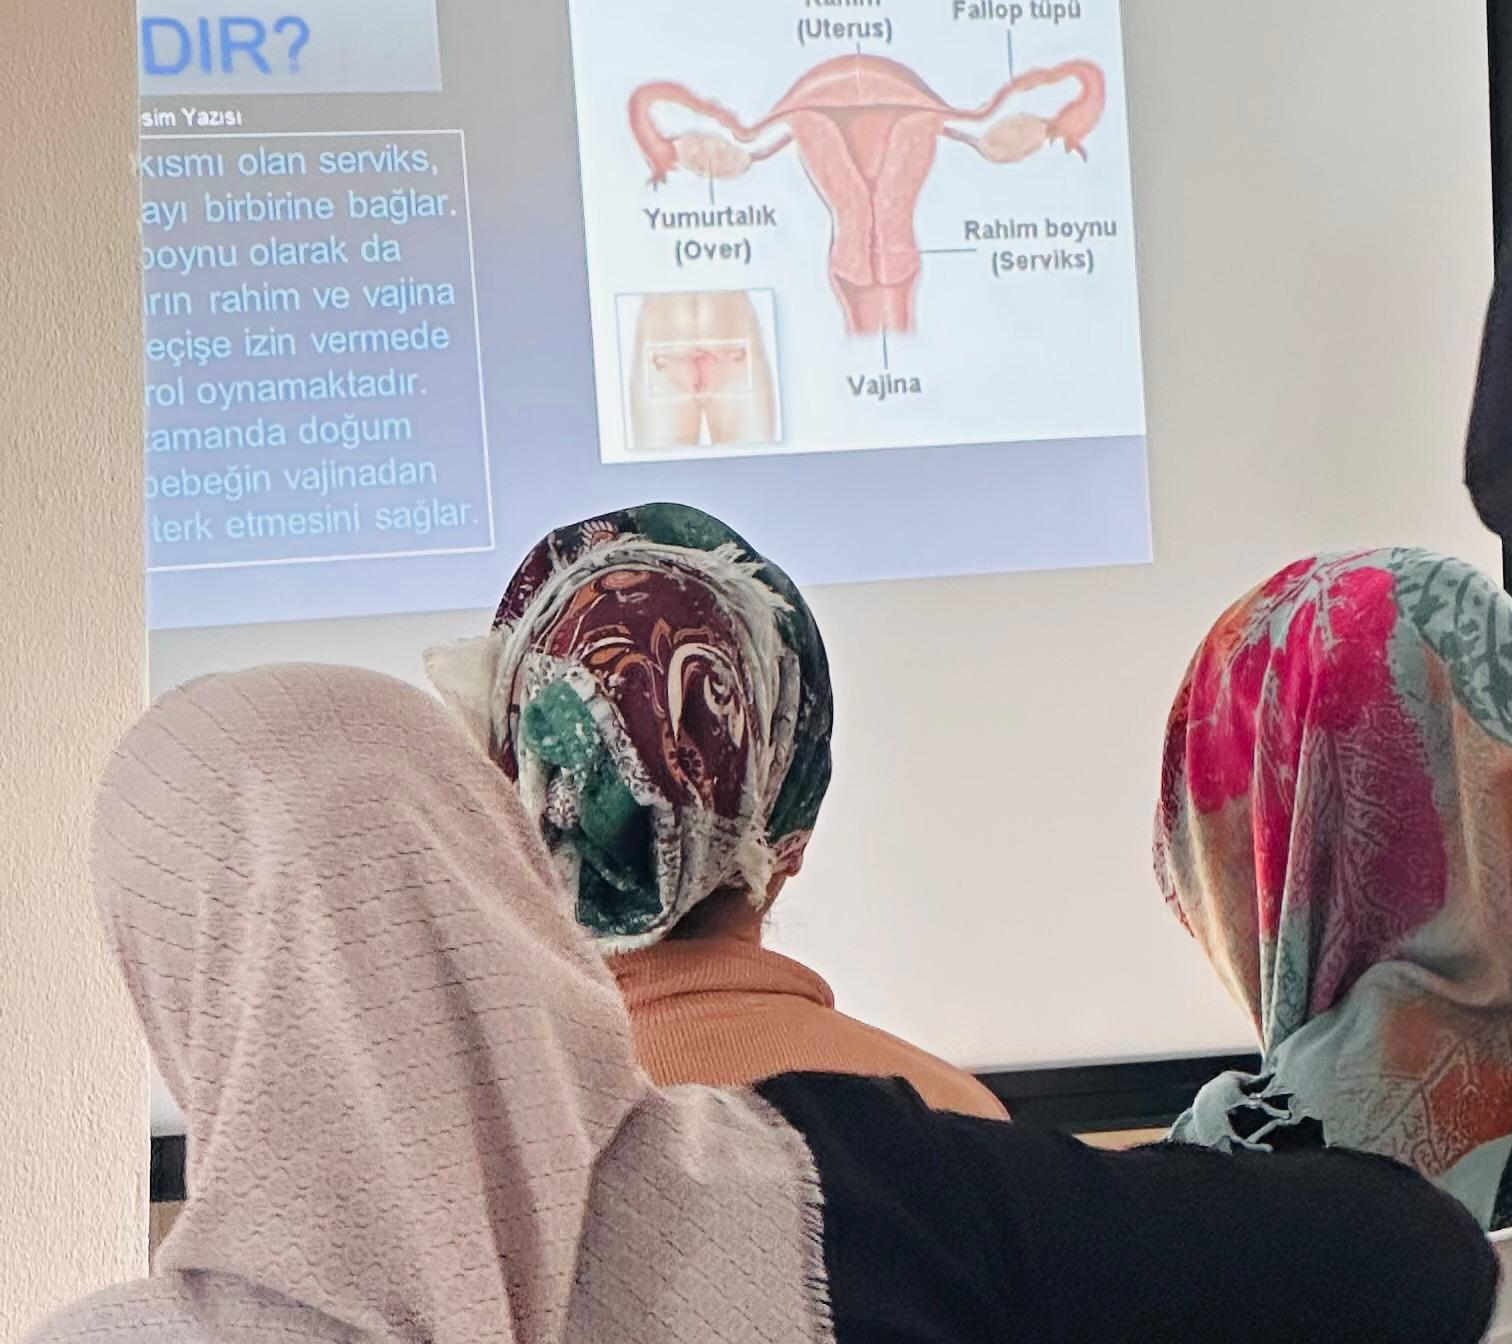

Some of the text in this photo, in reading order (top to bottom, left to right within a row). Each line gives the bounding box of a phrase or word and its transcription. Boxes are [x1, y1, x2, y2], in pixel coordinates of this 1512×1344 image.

[141, 16, 311, 75] DIR?
[797, 17, 893, 46] (Uterus)
[140, 107, 242, 127] sim Yazısı
[237, 145, 306, 176] olan
[319, 143, 439, 176] serviks,
[142, 188, 457, 232] ayı birbirine bağlar.
[643, 204, 777, 230] Yumurtalık
[963, 218, 1117, 243] Rahim boynu
[250, 233, 349, 267] olarak
[361, 232, 402, 263] da
[675, 237, 752, 268] (Over)
[992, 249, 1094, 278] (Serviks)
[143, 277, 455, 316] rın rahim ve vajina
[145, 320, 449, 367] eçişe izin vermede
[144, 367, 427, 411] rol oynamaktadır.
[846, 373, 922, 401] Vajina
[144, 413, 411, 453] amanda doğum
[284, 457, 437, 497] vajinadan
[152, 497, 479, 543] terk etmesini sağlar.
